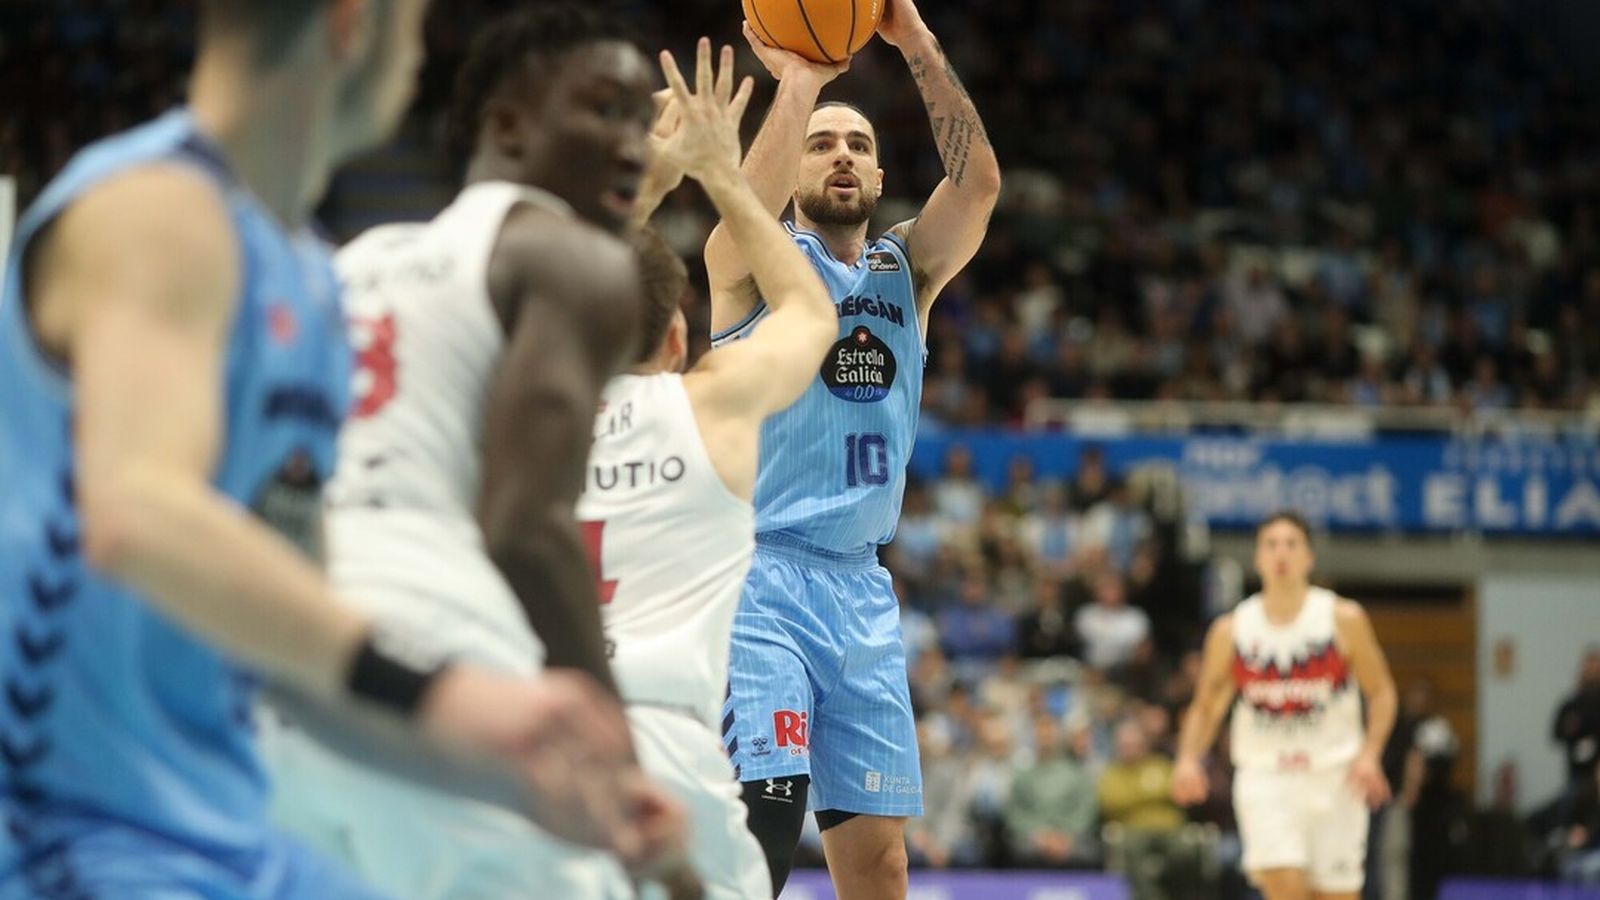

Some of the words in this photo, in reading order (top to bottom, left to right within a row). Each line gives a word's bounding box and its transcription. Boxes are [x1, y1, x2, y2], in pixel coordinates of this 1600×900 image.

[836, 348, 885, 366] Estrella
[583, 456, 685, 493] UTIO
[845, 432, 889, 488] 10
